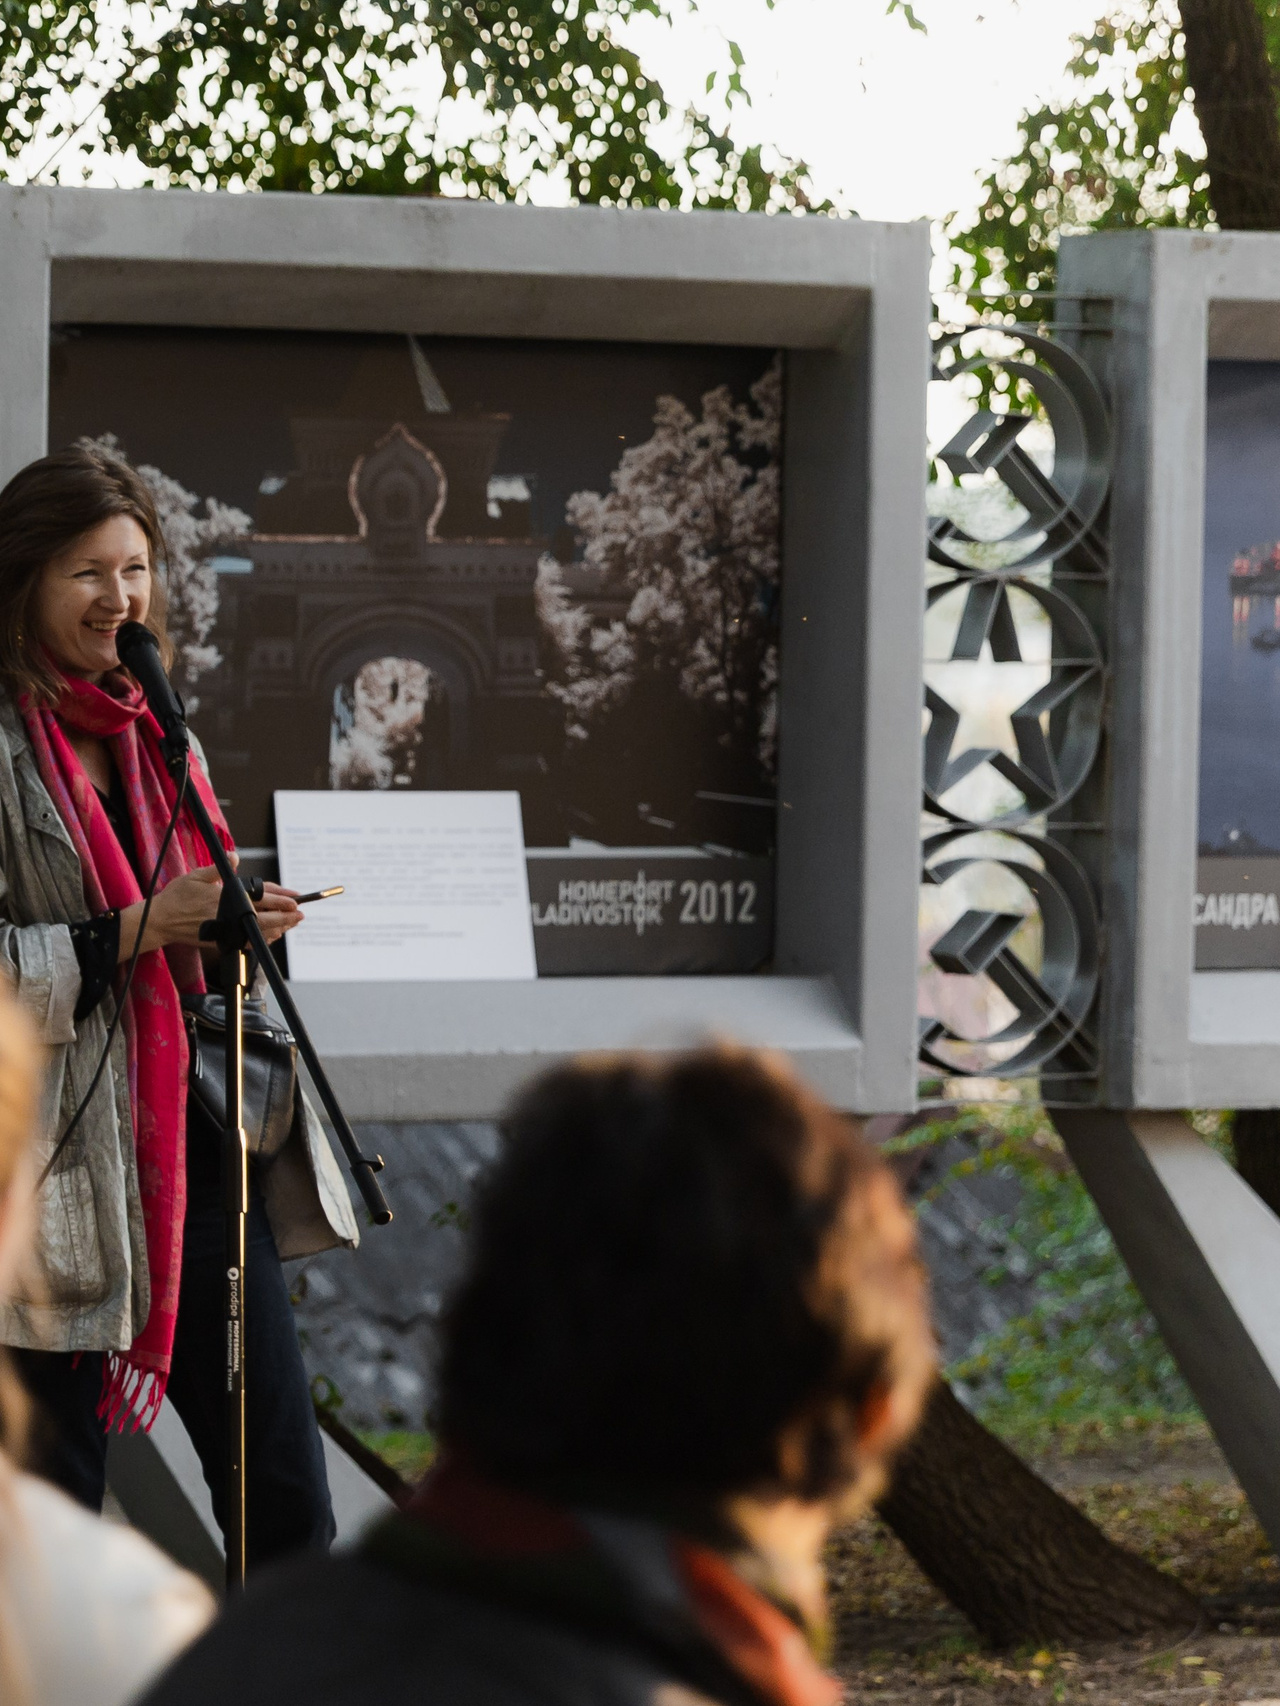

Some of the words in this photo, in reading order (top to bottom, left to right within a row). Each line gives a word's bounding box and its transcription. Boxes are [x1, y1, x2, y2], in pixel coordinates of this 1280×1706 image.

[531, 902, 664, 926] LADIVOSTOK
[558, 879, 676, 901] HOMEPORT
[679, 879, 757, 924] 2012
[1192, 892, 1280, 930] САНДРА
[230, 1281, 240, 1317] prodipe
